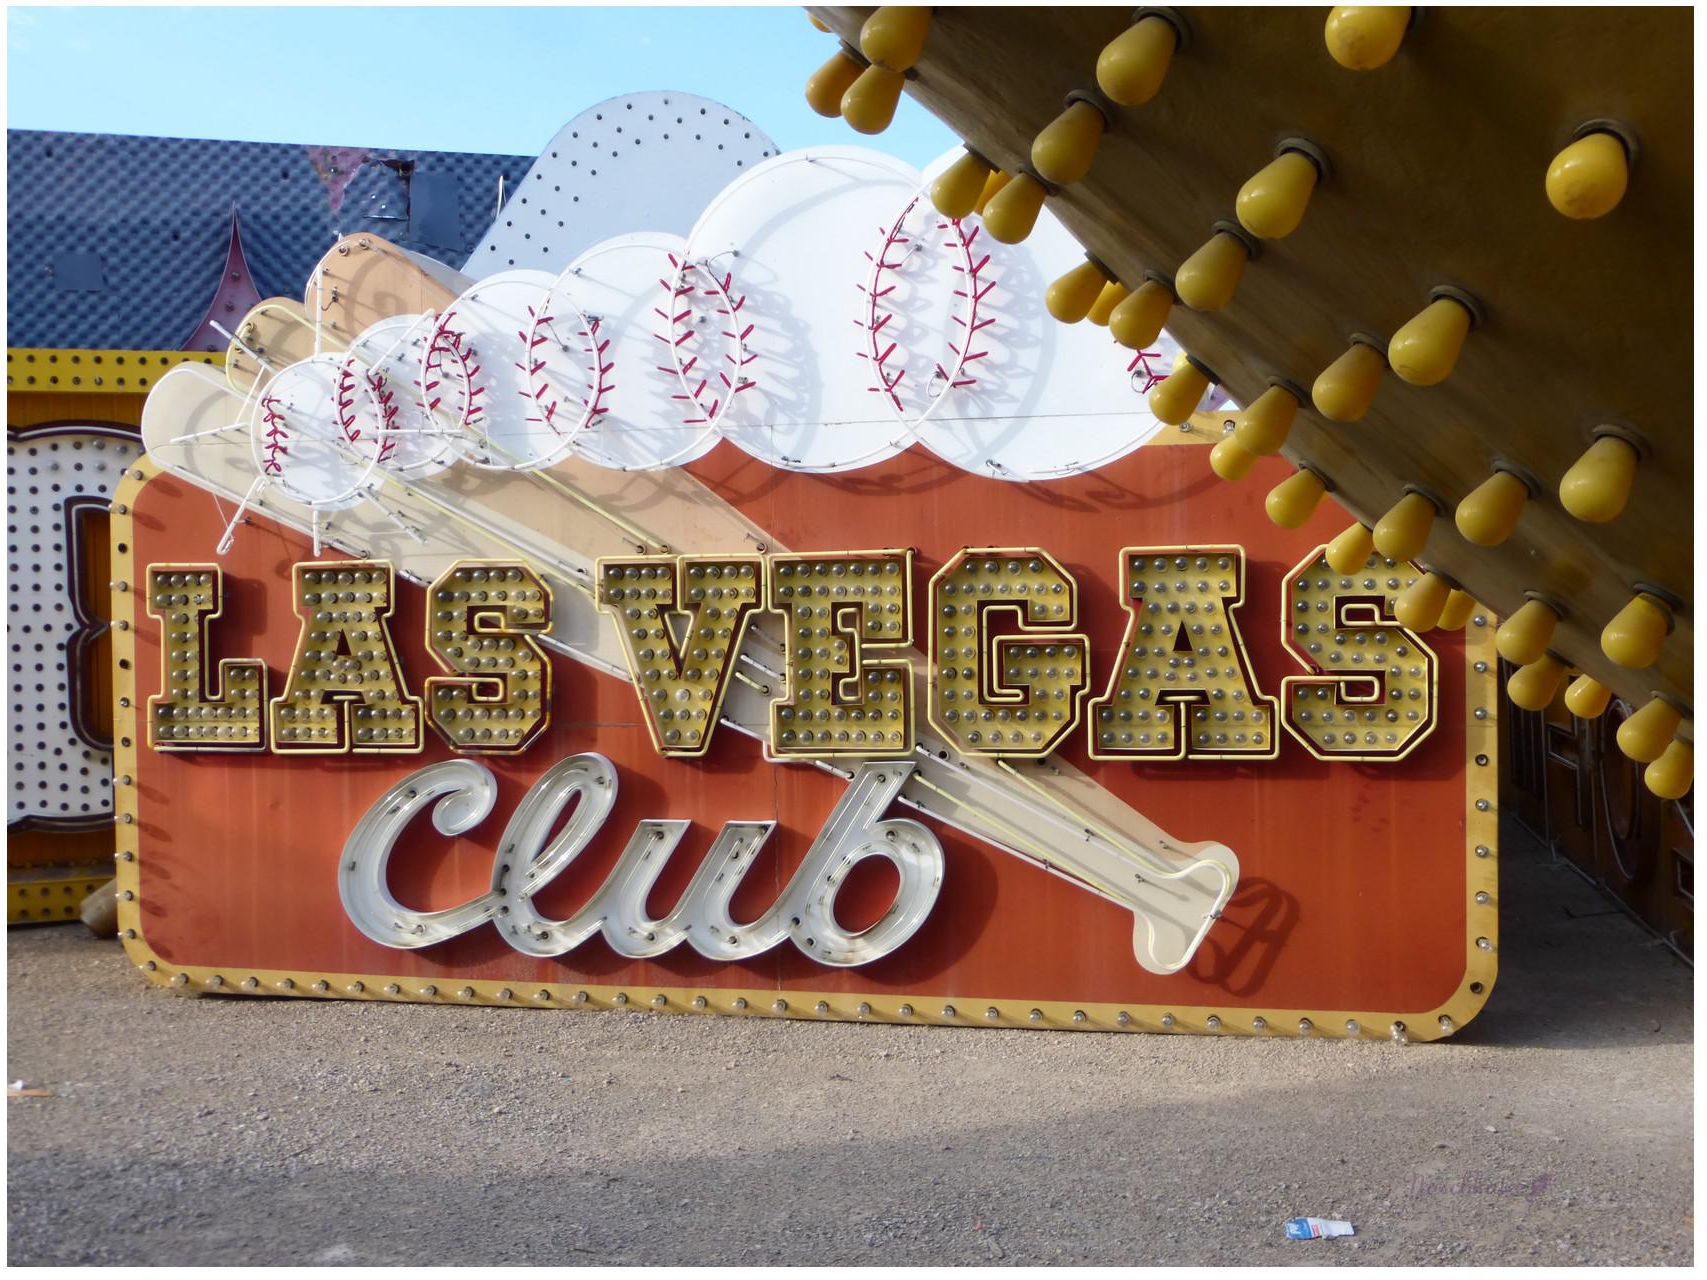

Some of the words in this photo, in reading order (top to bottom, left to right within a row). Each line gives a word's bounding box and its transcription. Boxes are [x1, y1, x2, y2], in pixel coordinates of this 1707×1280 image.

[145, 558, 553, 756] LAS
[597, 542, 1440, 762] VEGAS
[337, 750, 945, 968] Club
